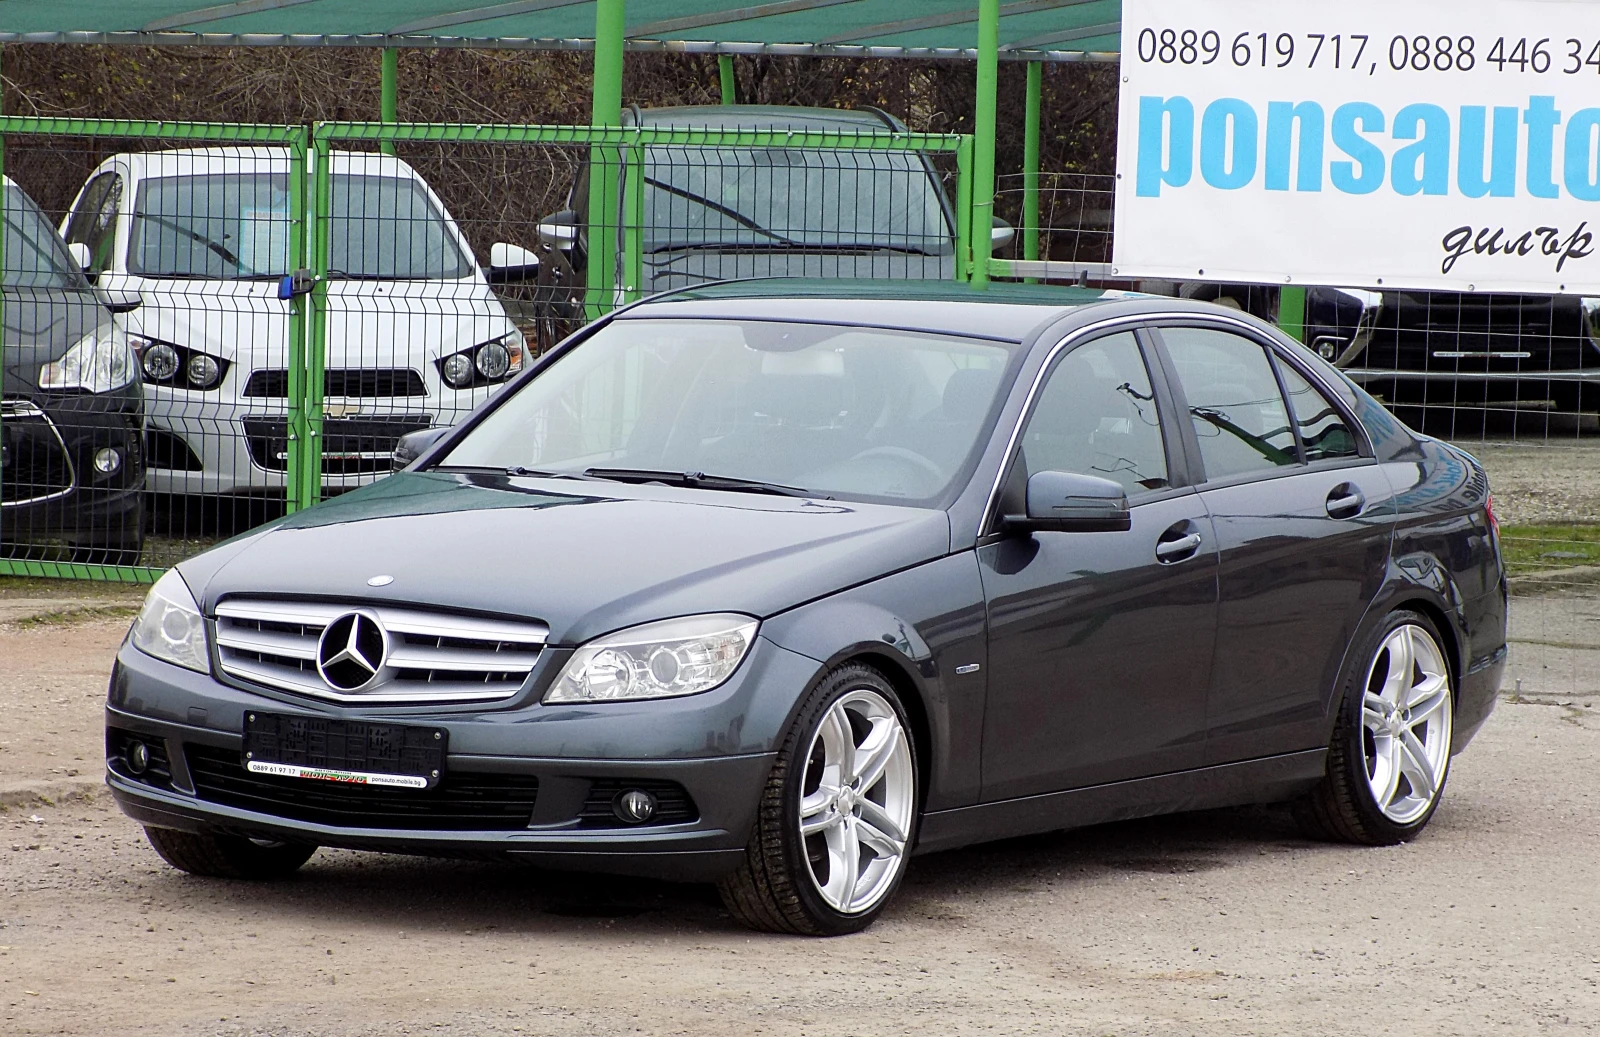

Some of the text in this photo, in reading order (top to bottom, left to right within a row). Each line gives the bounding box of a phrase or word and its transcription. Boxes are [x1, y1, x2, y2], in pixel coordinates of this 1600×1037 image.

[1137, 27, 1221, 65] 0889
[1231, 31, 1295, 68] 619
[1306, 33, 1378, 76] 717,
[1388, 34, 1476, 72] 0888
[1486, 36, 1552, 74] 446
[1135, 94, 1600, 202] ponsauto
[1440, 220, 1596, 275] дилър
[252, 764, 268, 772] 0889
[371, 777, 421, 787] ponsauto.mobile.bg
